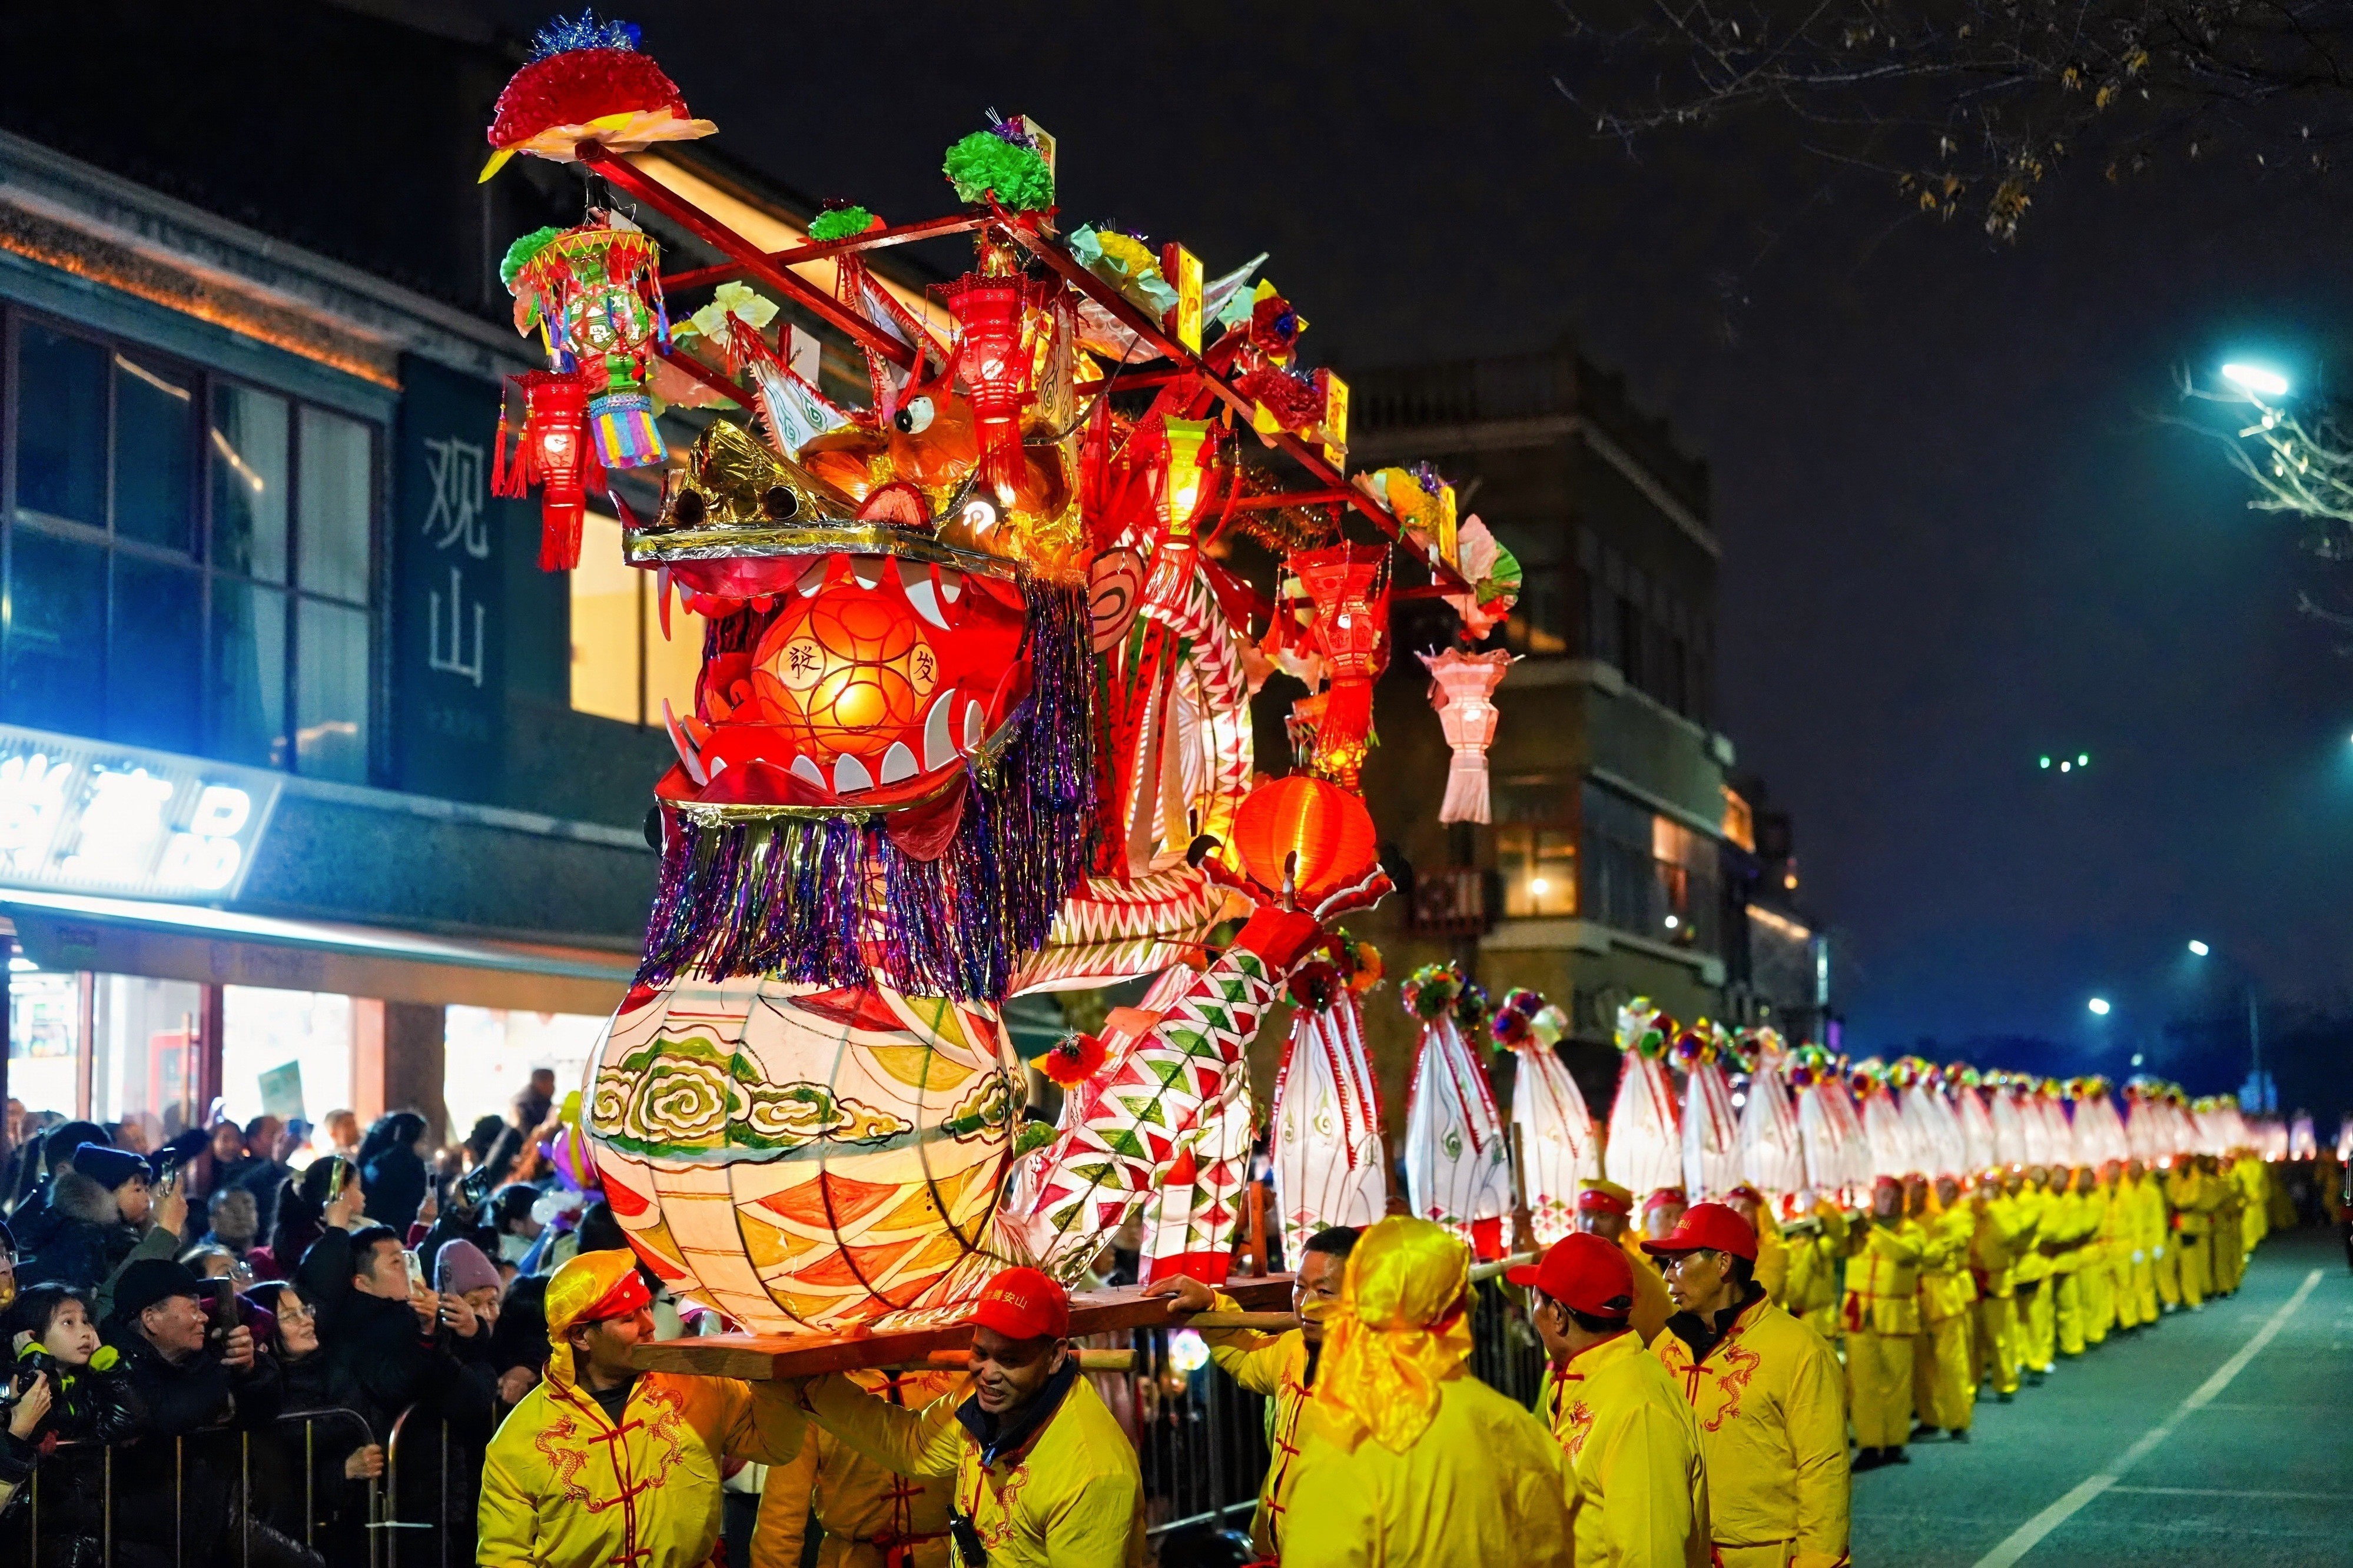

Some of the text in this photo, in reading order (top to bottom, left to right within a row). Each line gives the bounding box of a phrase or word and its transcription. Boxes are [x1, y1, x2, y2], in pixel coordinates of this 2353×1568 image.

[421, 433, 490, 689] 观山
[784, 646, 822, 680] 發
[914, 650, 935, 684] 发
[984, 1289, 1027, 1310] 龙腾安山
